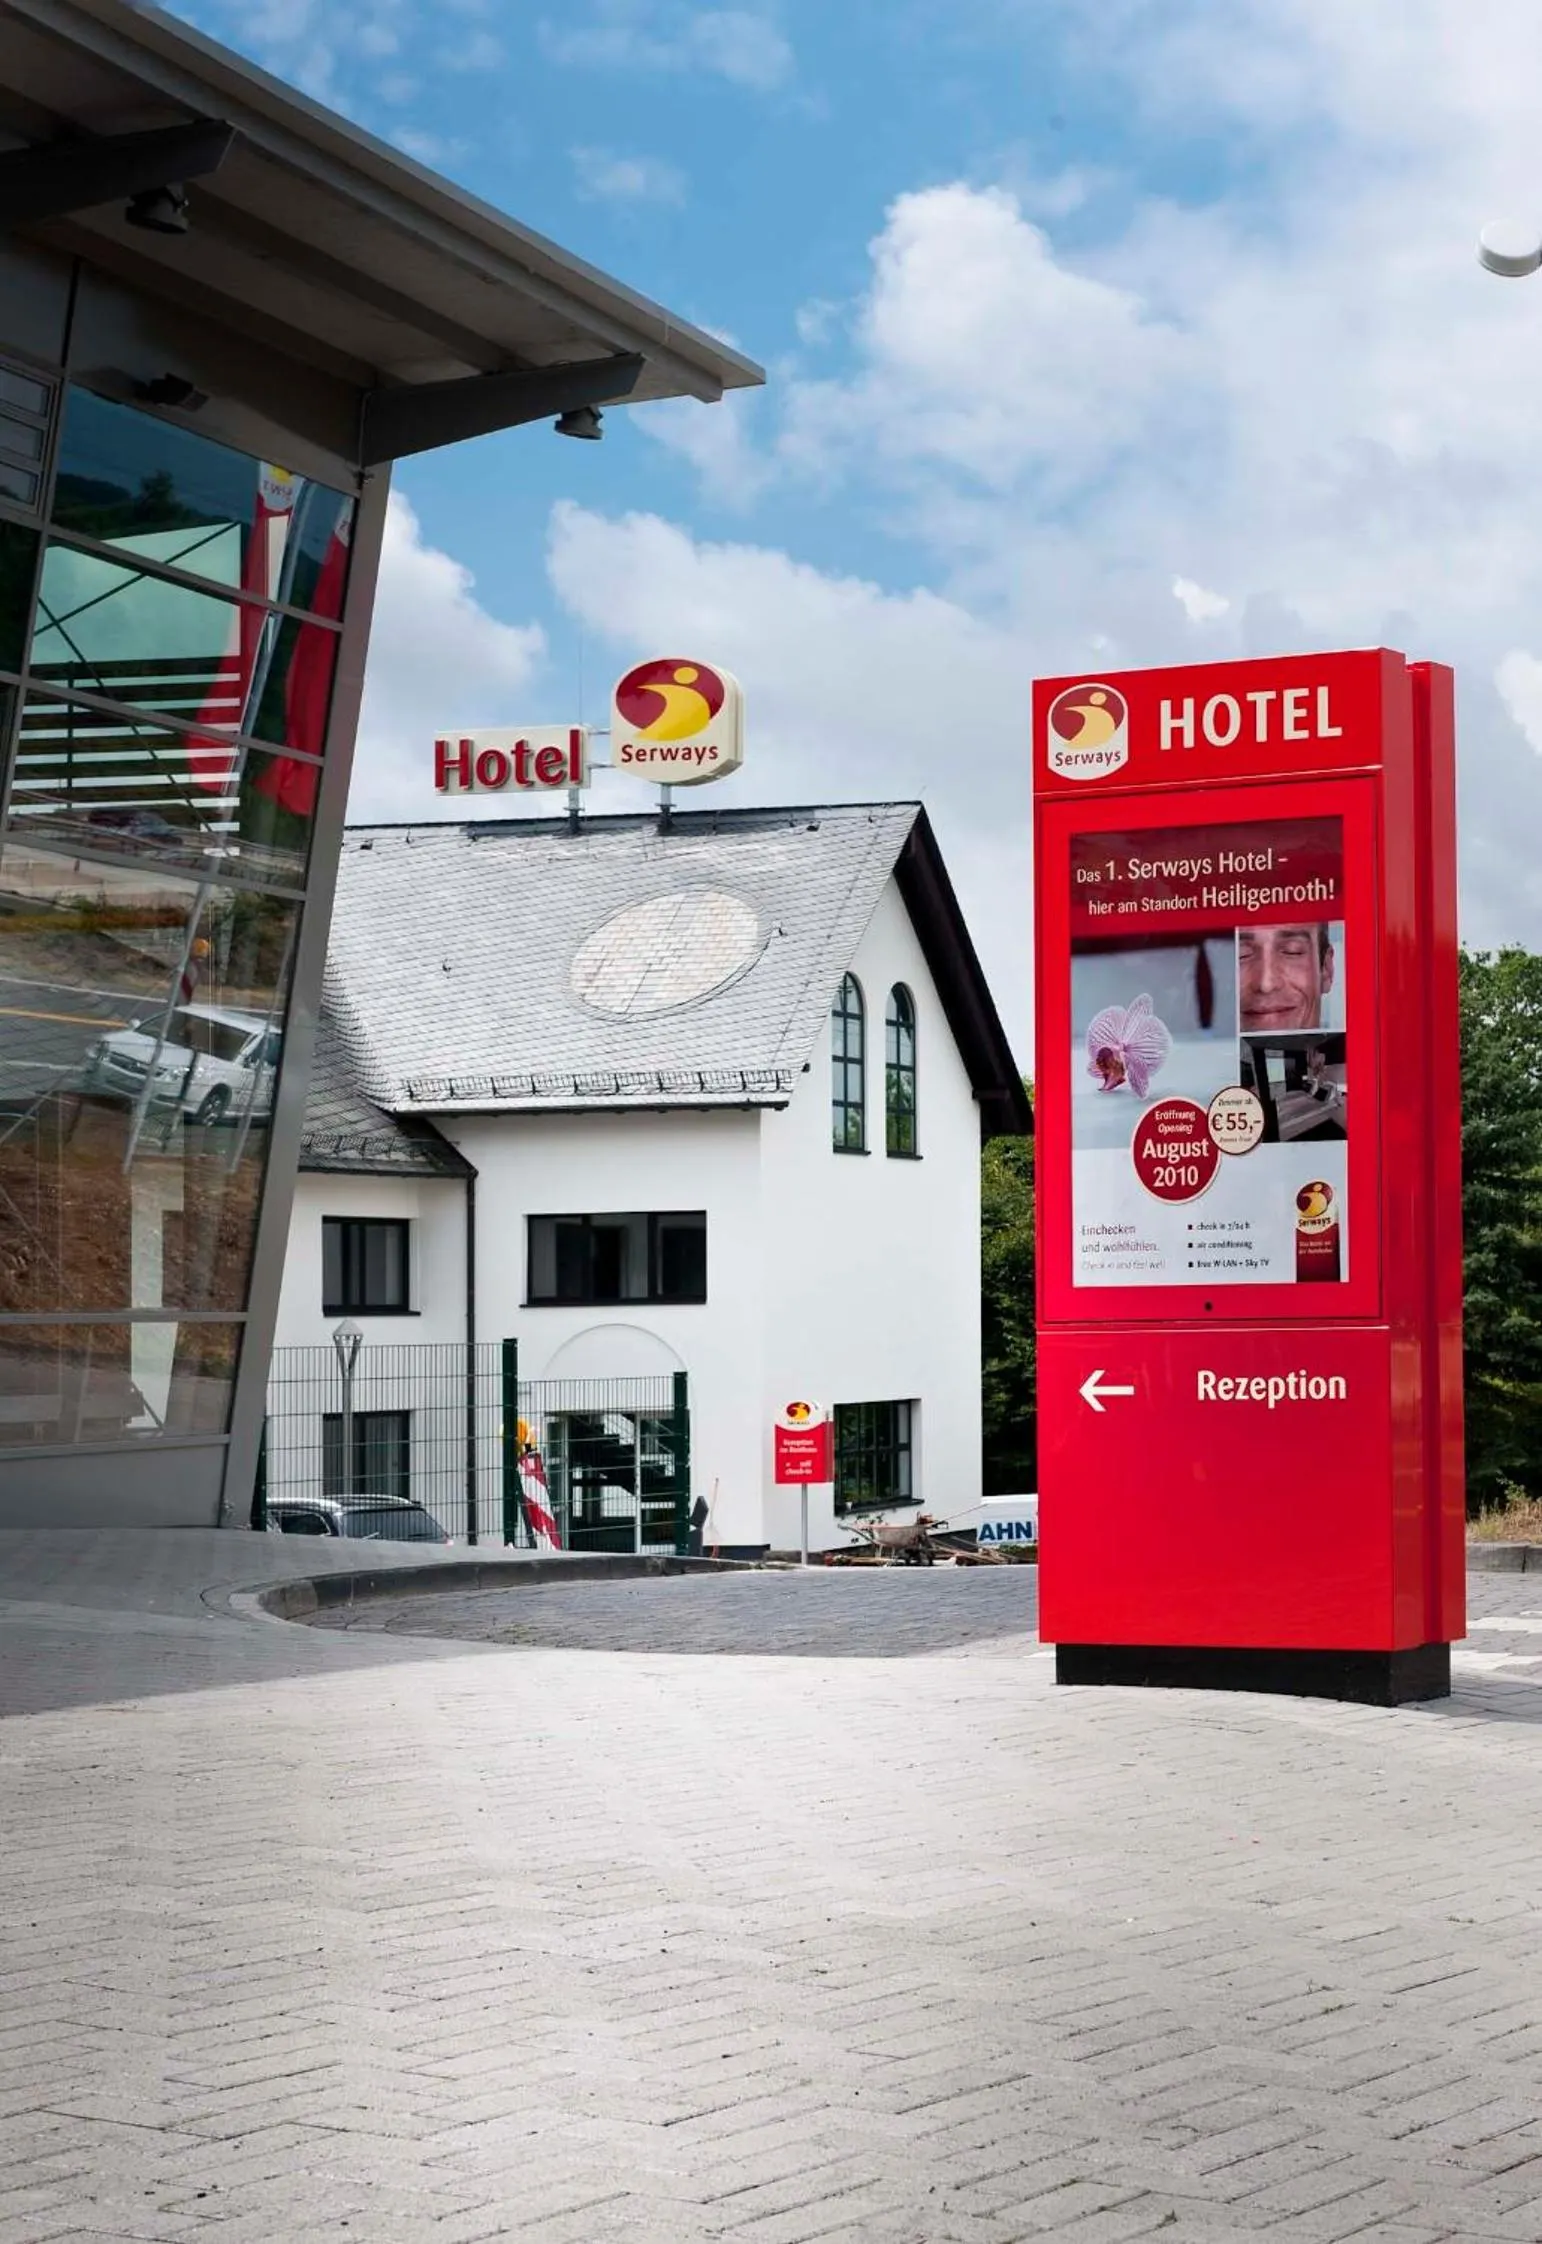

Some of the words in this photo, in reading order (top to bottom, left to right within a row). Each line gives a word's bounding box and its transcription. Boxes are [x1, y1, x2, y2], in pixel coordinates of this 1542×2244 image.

[1159, 686, 1343, 751] HOTEL
[435, 728, 582, 791] Hotel
[621, 744, 719, 766] Serways
[1054, 749, 1121, 768] Serways
[1077, 868, 1101, 883] Das
[1105, 860, 1122, 881] 1.
[1128, 856, 1212, 881] Serways
[1218, 847, 1272, 873] Hotel
[1088, 900, 1115, 915] hier
[1118, 901, 1138, 914] am
[1141, 895, 1198, 912] Standort
[1202, 878, 1335, 911] Heiligenroth!
[1157, 1123, 1194, 1135] Opening
[1142, 1138, 1209, 1164] August
[1153, 1165, 1199, 1187] 2010
[1081, 1224, 1136, 1236] Einchecken
[1298, 1217, 1331, 1227] Serways
[1082, 1240, 1100, 1253] und
[1245, 1259, 1258, 1268] Sky
[1260, 1259, 1270, 1267] TV
[1197, 1369, 1346, 1409] Rezeption
